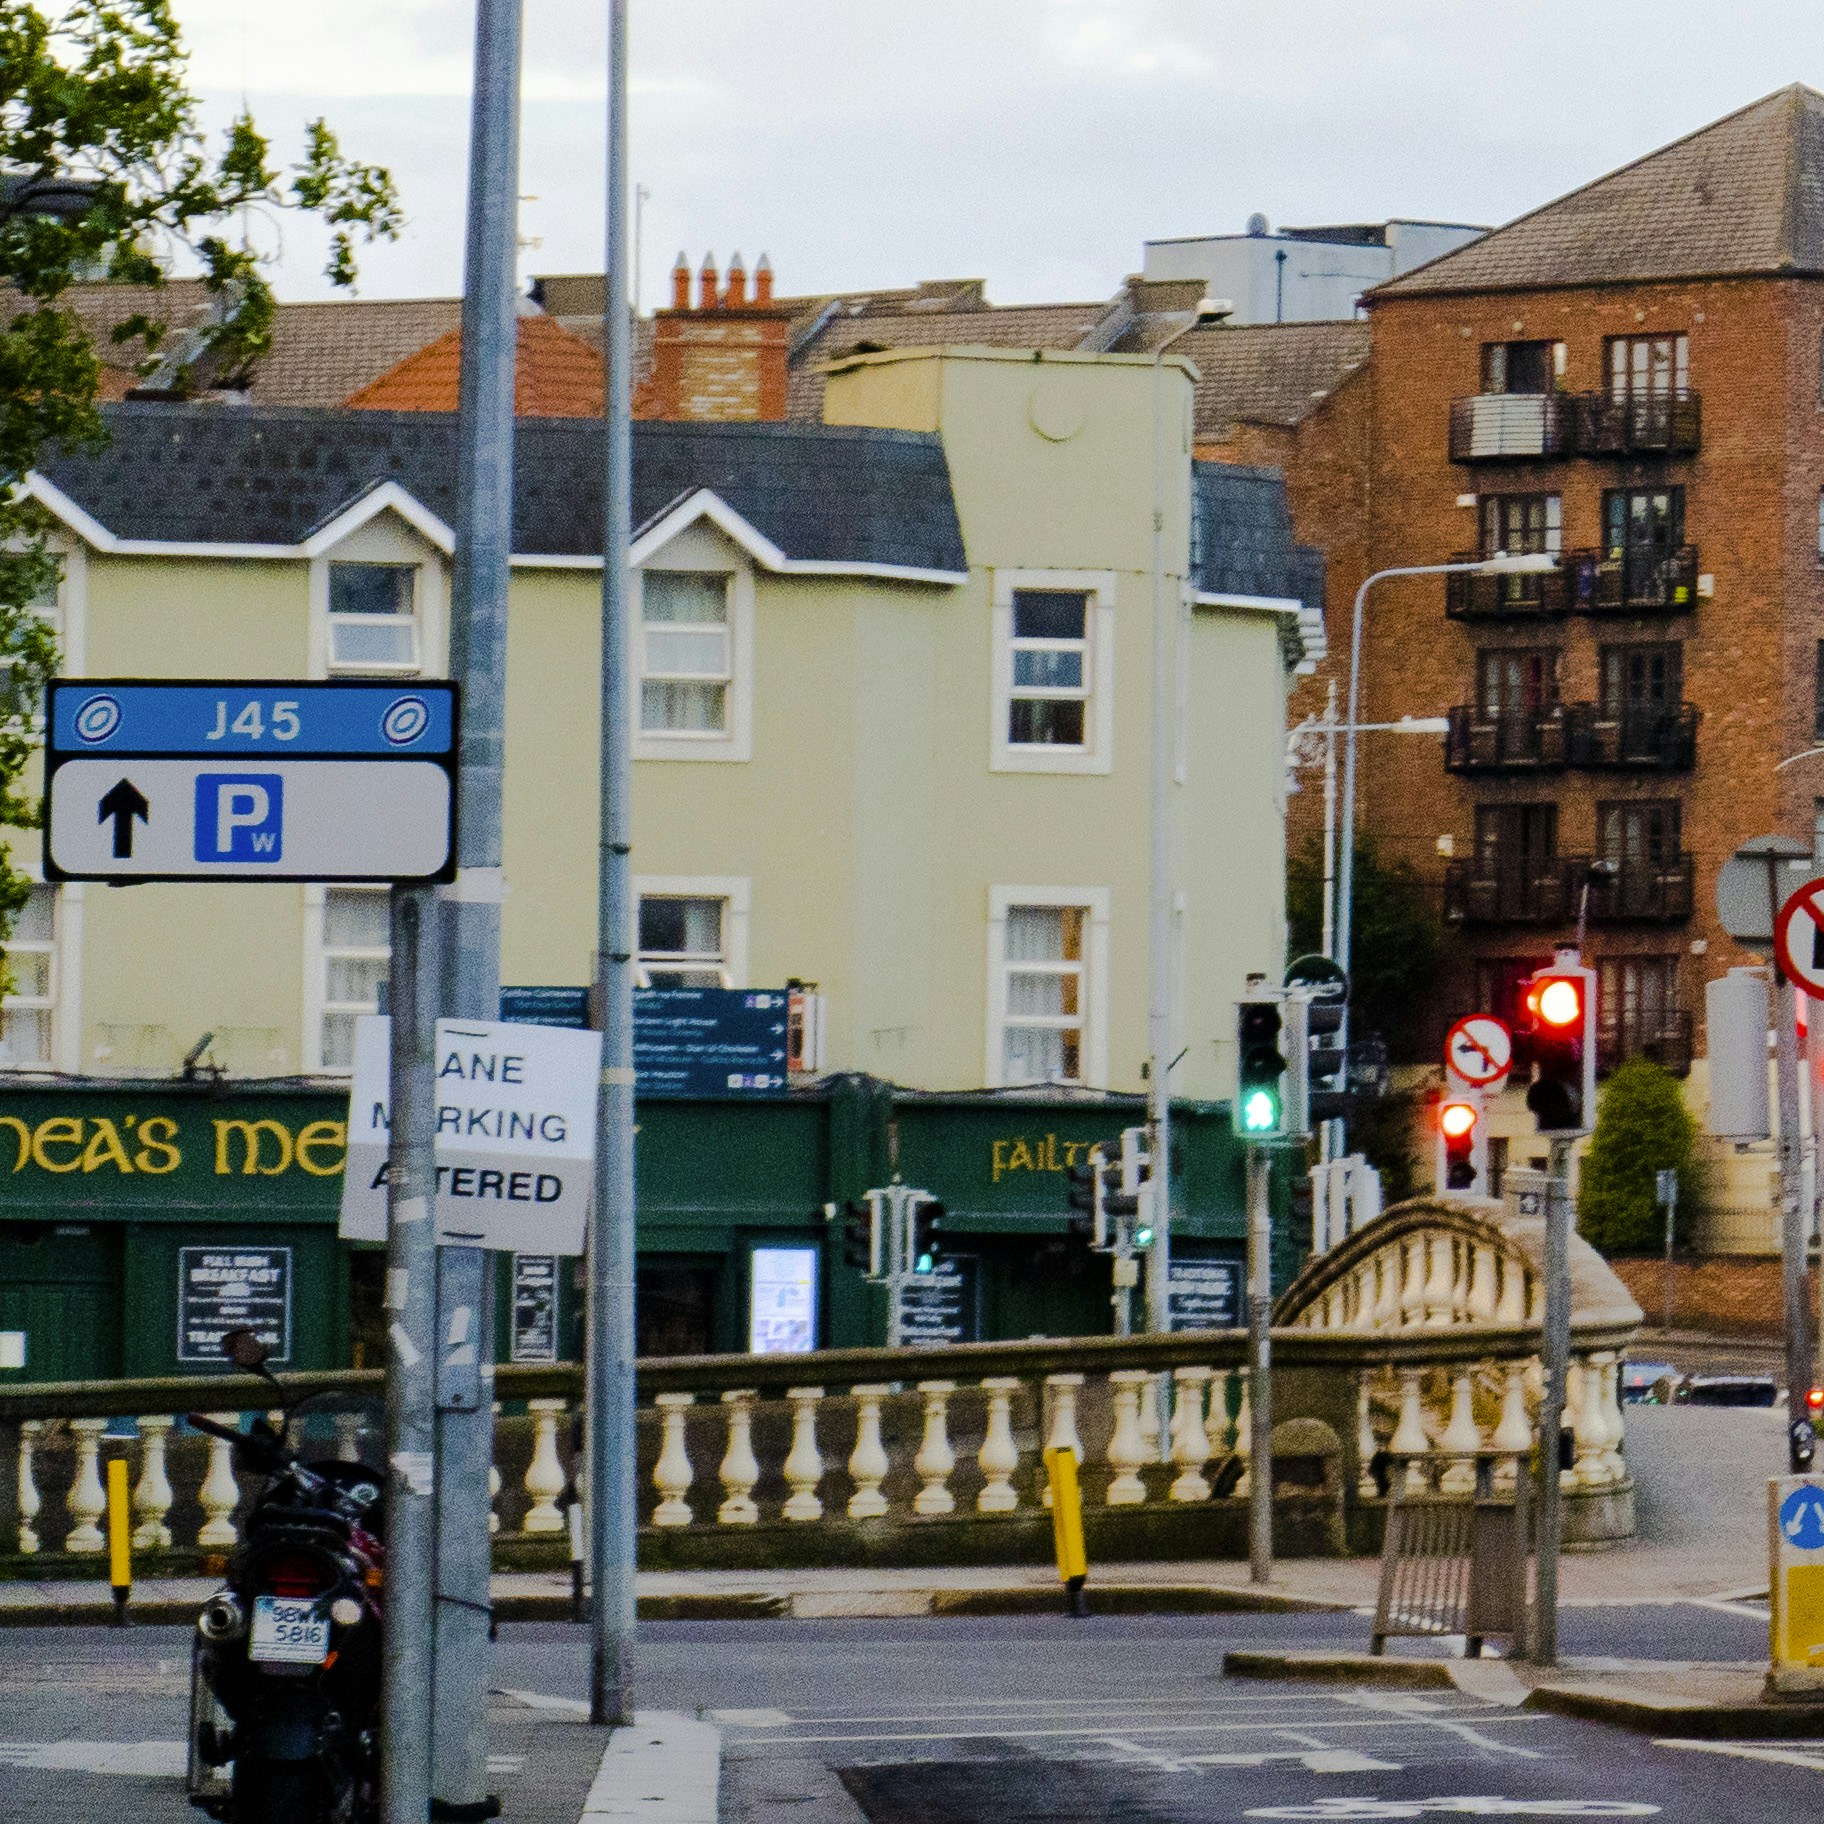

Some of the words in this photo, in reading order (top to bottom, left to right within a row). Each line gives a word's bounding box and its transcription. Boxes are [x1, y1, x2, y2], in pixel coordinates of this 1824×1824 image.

[206, 701, 301, 741] J45
[216, 783, 270, 853] P
[439, 1051, 524, 1084] ANE
[372, 1101, 567, 1142] MRKING
[370, 1161, 563, 1203] ATERED
